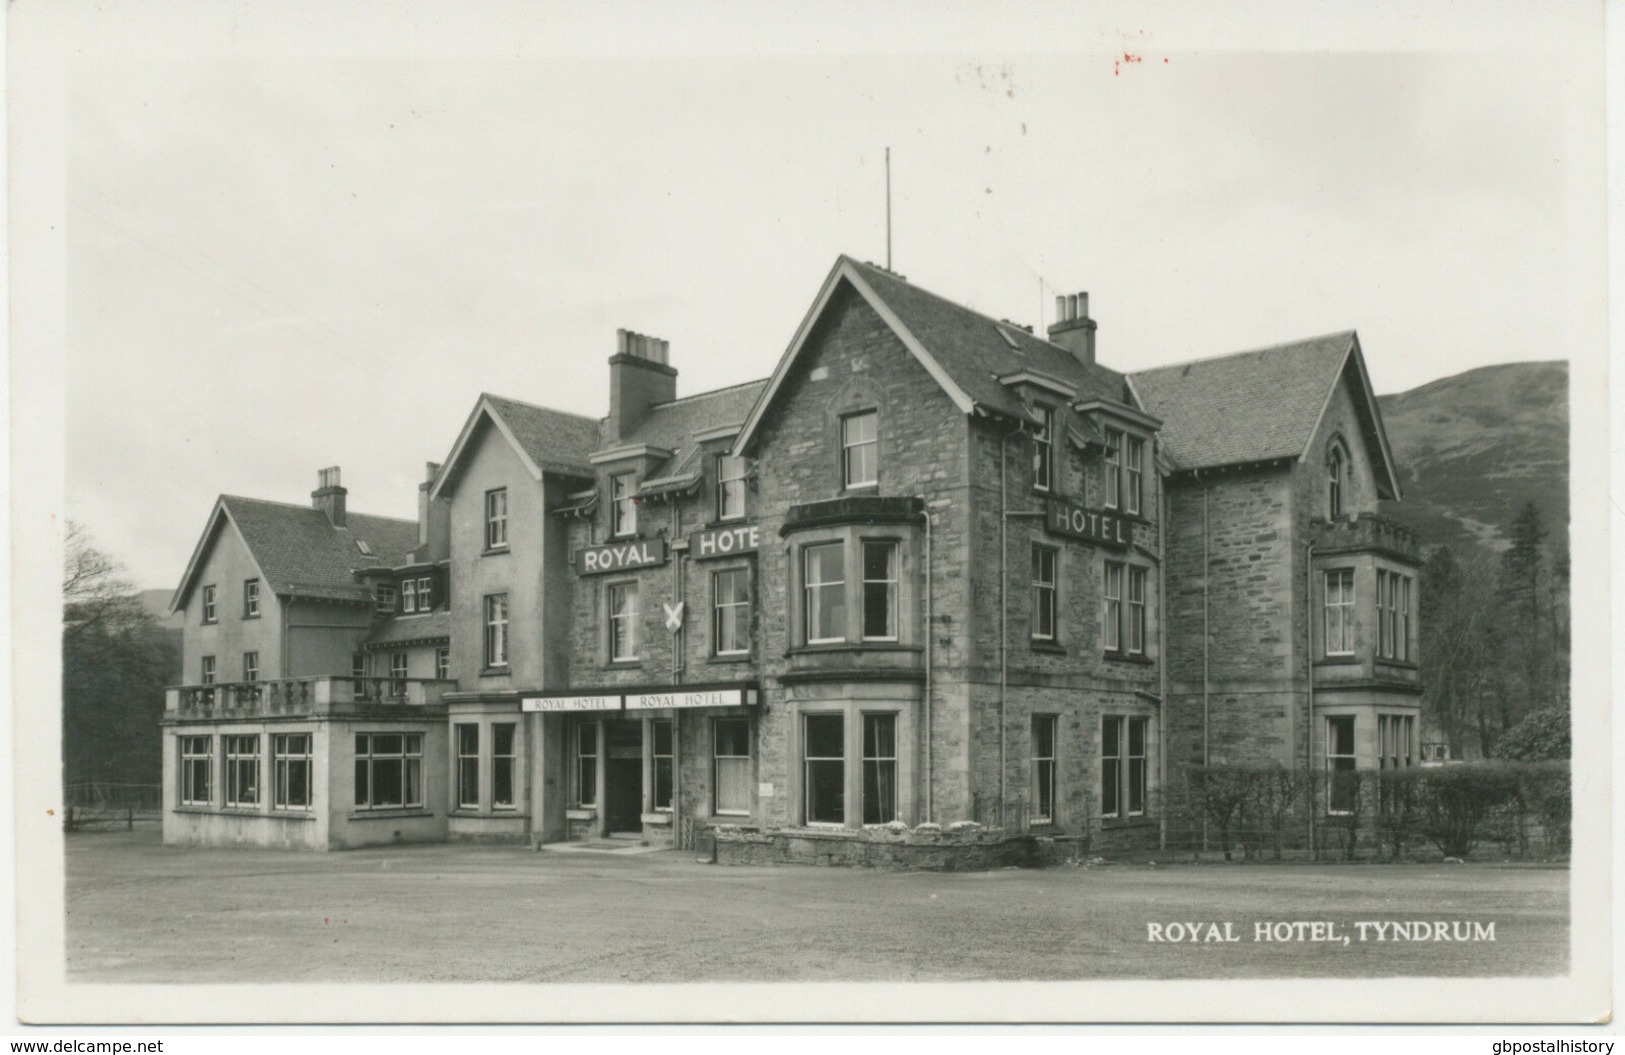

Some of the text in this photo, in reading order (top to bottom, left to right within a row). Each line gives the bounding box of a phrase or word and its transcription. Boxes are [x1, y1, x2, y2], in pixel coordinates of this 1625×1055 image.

[1056, 507, 1126, 543] HOTEL
[585, 526, 759, 571] ROYAL HOTE
[534, 697, 607, 710] ROYAL HOTEL
[640, 692, 724, 708] ROYAL HOTEL
